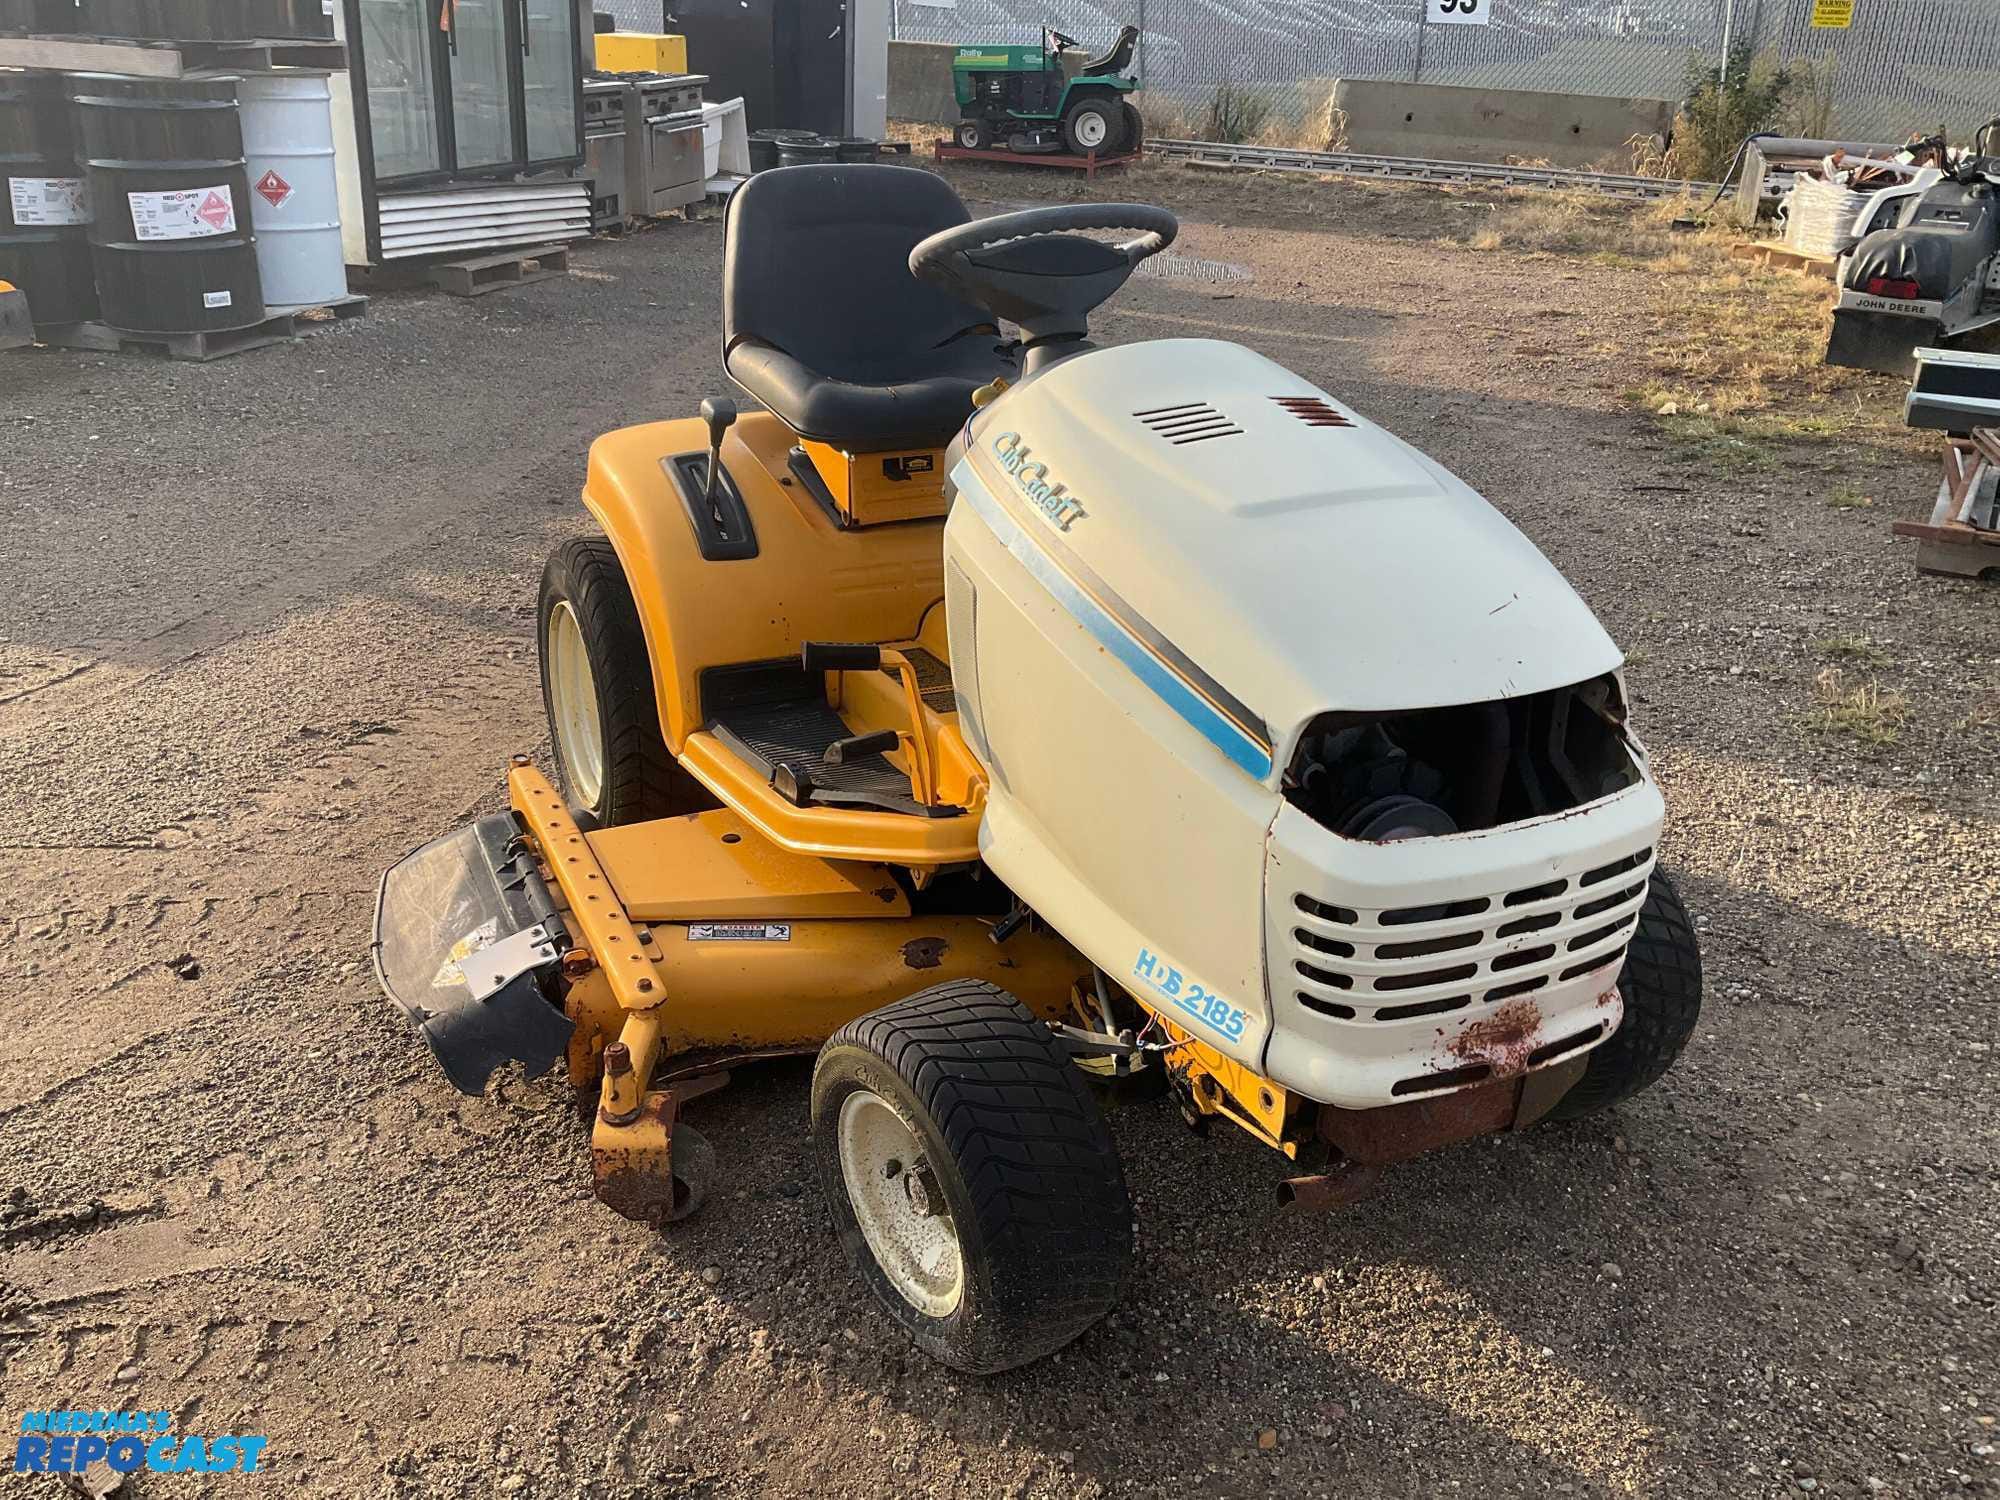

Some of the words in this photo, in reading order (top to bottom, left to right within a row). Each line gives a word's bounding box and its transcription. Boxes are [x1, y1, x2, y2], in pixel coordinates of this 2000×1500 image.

[1856, 300, 1885, 309] JOHN
[1889, 303, 1927, 314] DEERE
[992, 431, 1031, 475] Cub
[1184, 984, 1244, 1035] 2185
